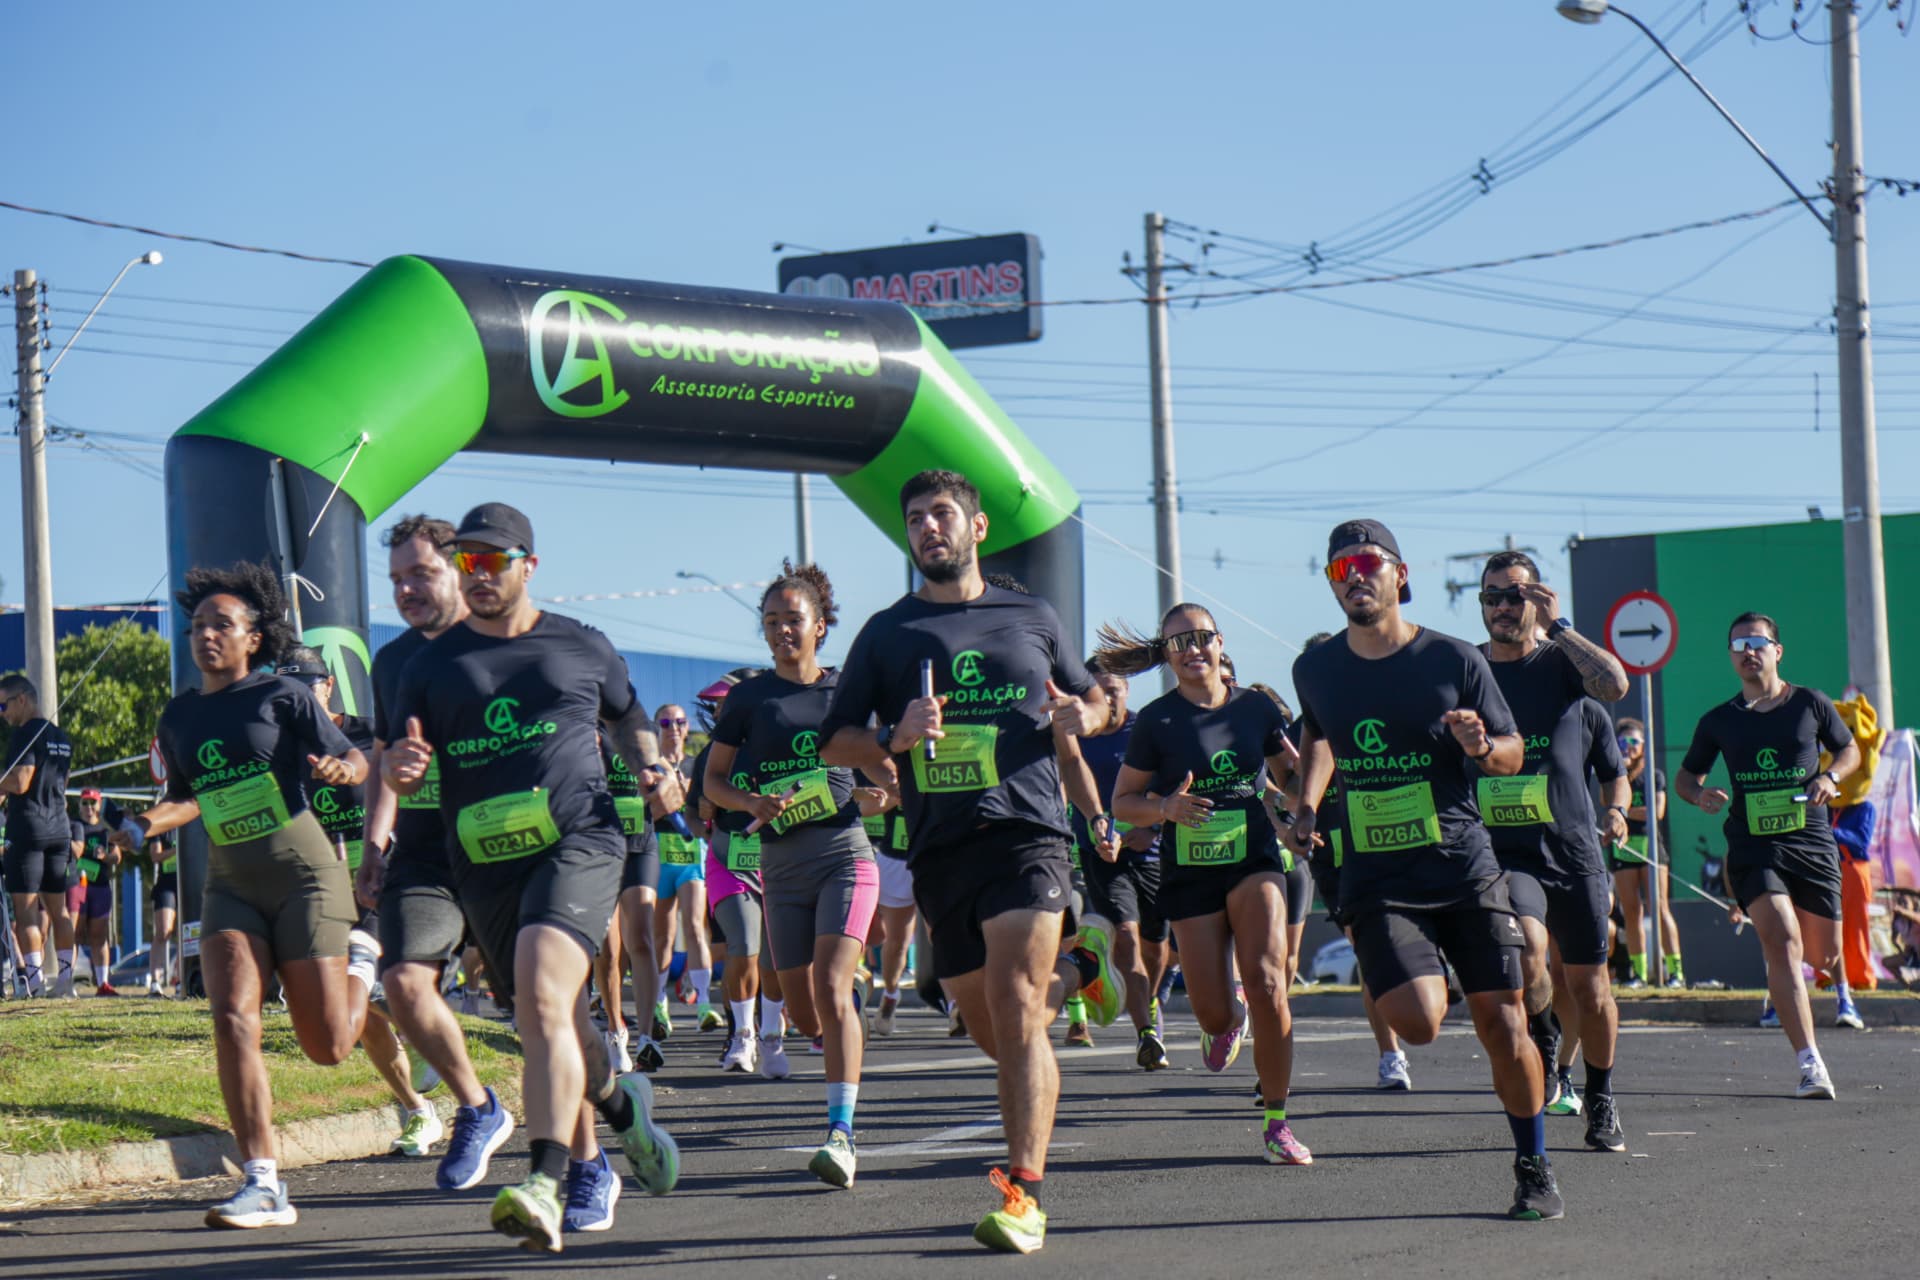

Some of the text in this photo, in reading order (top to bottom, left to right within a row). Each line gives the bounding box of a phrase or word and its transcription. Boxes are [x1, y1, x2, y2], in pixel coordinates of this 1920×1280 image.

[853, 261, 1023, 303] MARTINS
[627, 320, 880, 382] CORPORAÇÃO
[651, 375, 855, 410] Assessoria Esportiva
[944, 683, 1027, 704] PORAÇÃO
[760, 757, 827, 772] CORPORA
[928, 765, 979, 785] 045A
[1735, 766, 1806, 782] CORPORAÇÃO
[411, 783, 440, 801] 49
[224, 811, 276, 838] 009A
[782, 801, 823, 827] 010A
[1494, 807, 1538, 822] 046A
[1762, 815, 1795, 830] 021A
[484, 831, 541, 855] 023A
[1370, 823, 1424, 846] 026A
[1192, 844, 1232, 860] 002A
